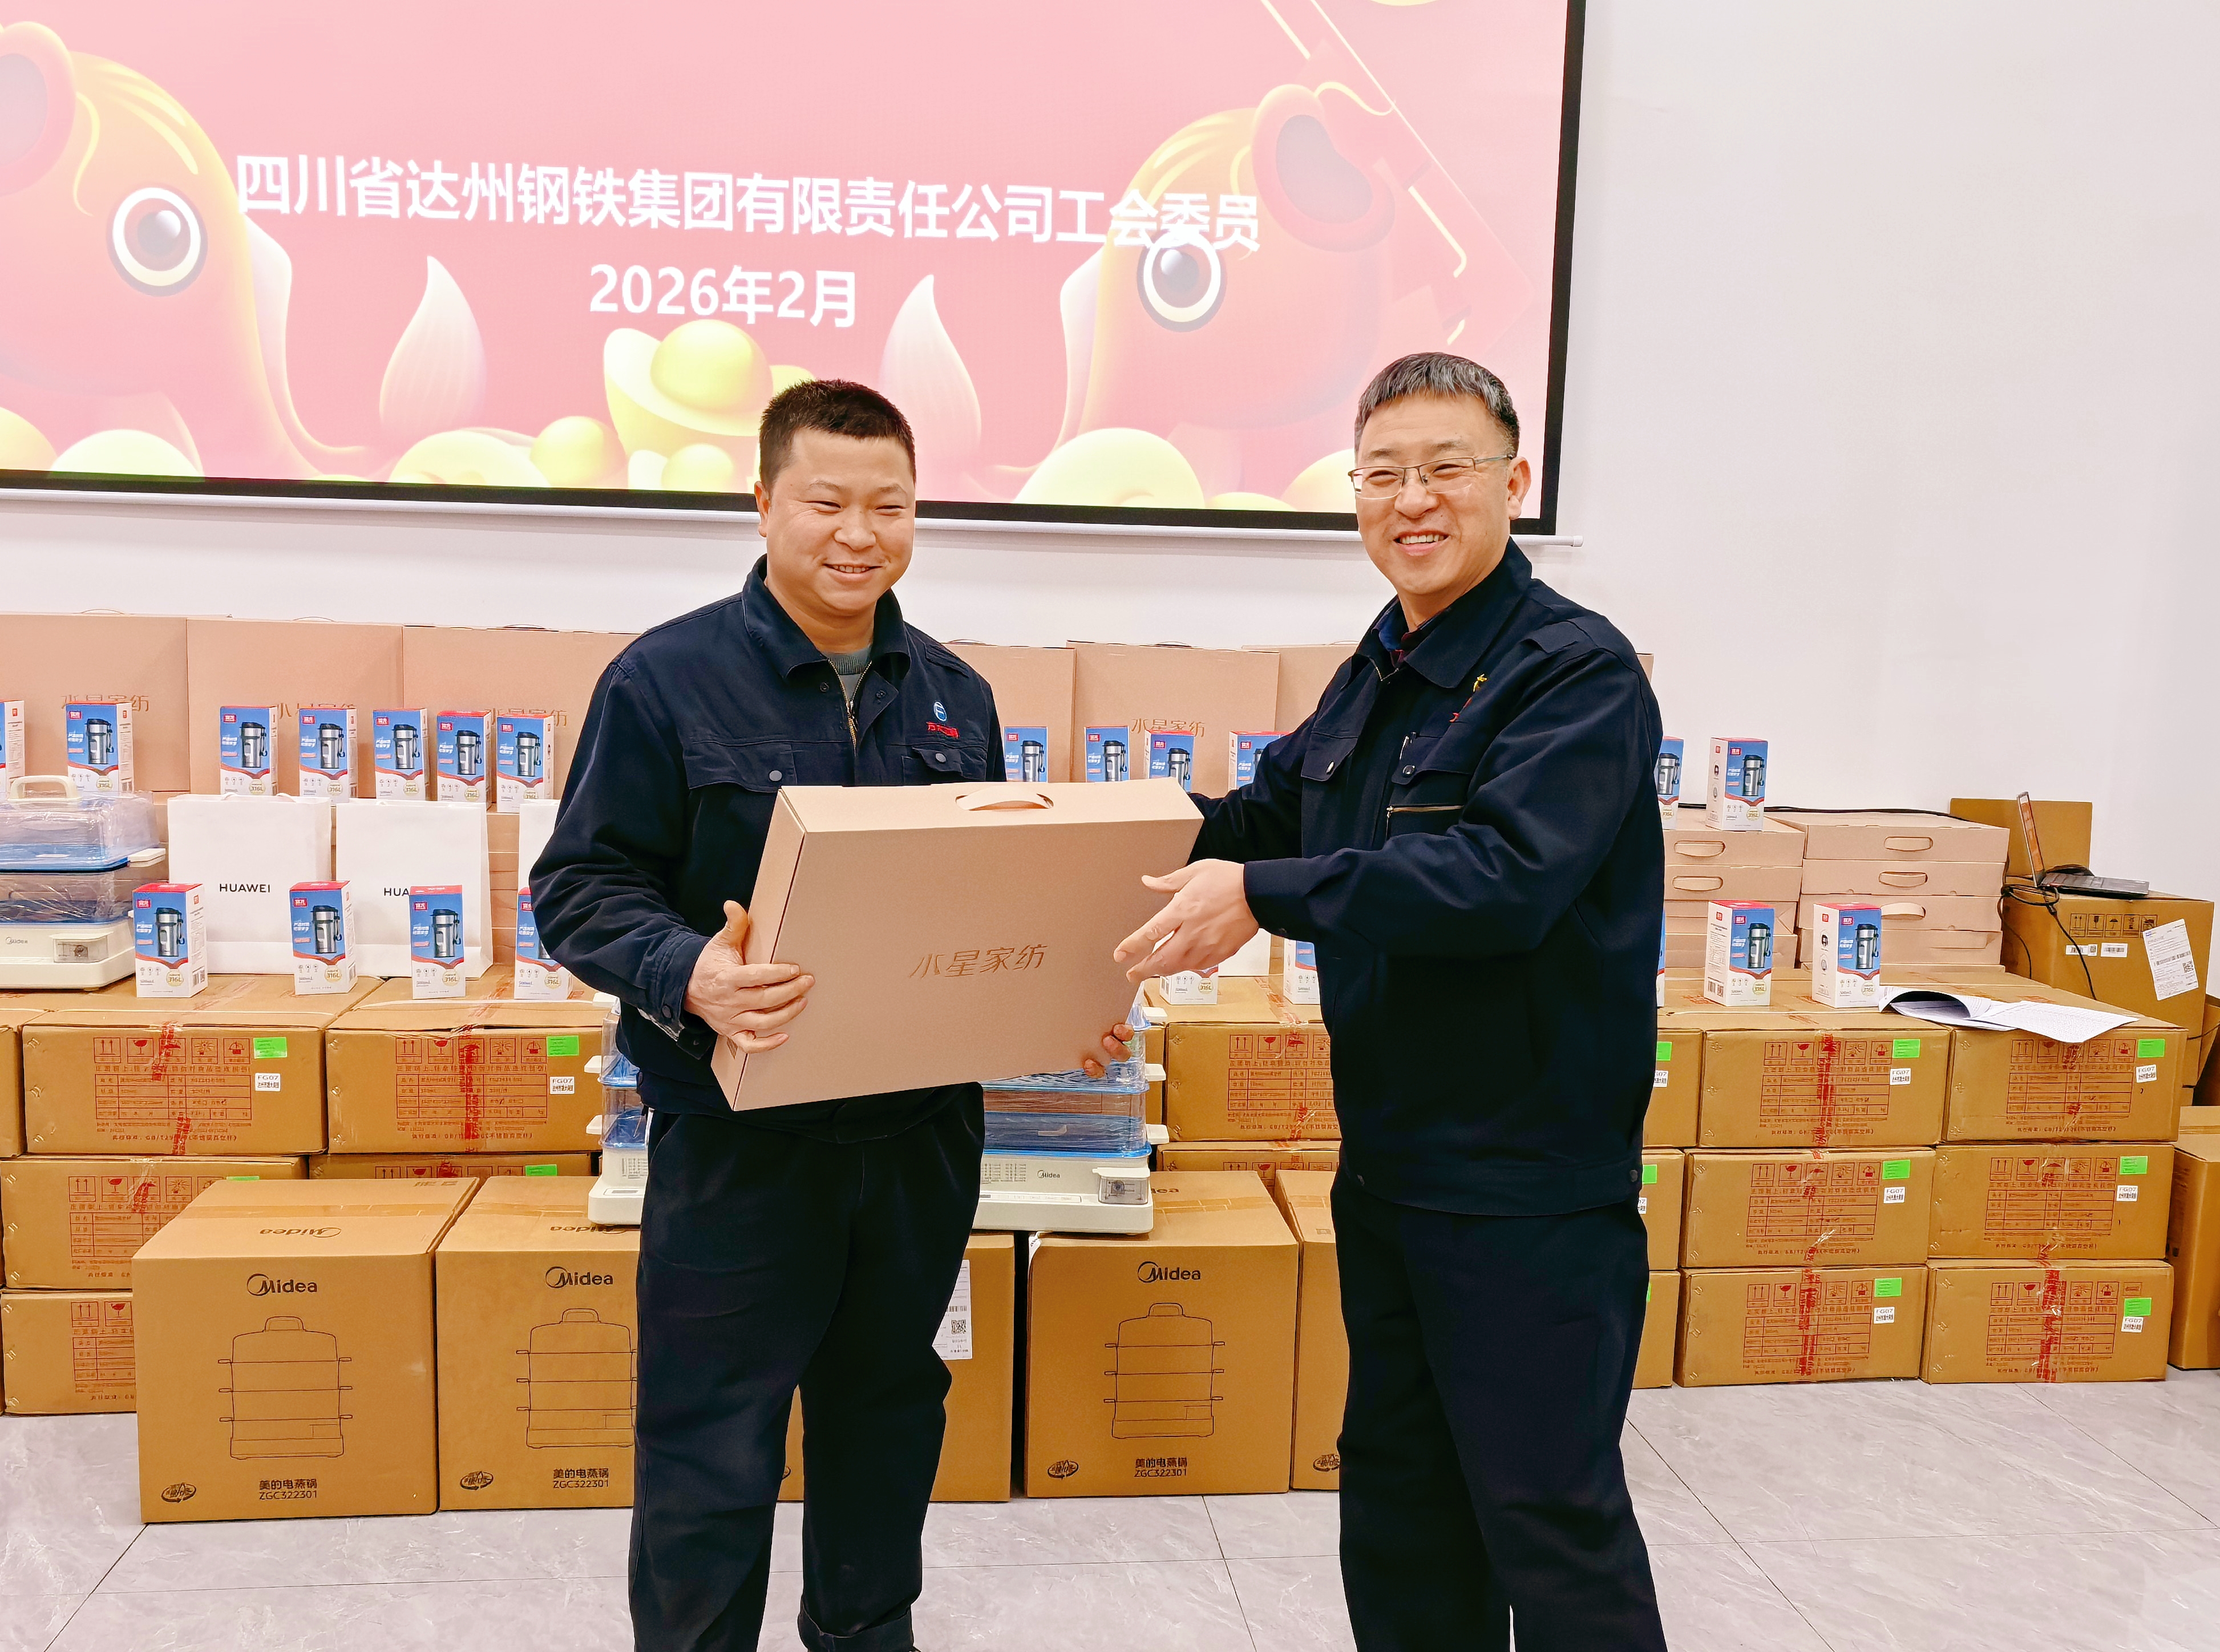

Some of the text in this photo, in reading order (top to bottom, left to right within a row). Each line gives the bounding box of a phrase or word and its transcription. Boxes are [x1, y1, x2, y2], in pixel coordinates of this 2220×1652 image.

[236, 154, 1260, 252] 四川省达州钢铁集团有限责任公司工会委员
[589, 264, 856, 327] 2026年2月
[219, 883, 271, 893] HUAWEI
[383, 887, 410, 897] HUA
[908, 943, 1050, 979] 水星家纺
[1037, 1169, 1061, 1179] Midea
[260, 1227, 342, 1238] Midea
[1138, 1261, 1201, 1283] Midea
[545, 1266, 614, 1289] Midea
[246, 1273, 318, 1296] Midea
[553, 1468, 609, 1478] 美的电蒸锅
[1134, 1468, 1188, 1477] ZGC322301
[259, 1479, 318, 1489] 美的电蒸锅
[553, 1479, 609, 1488] ZGC322301
[259, 1490, 318, 1500] ZGC322301
